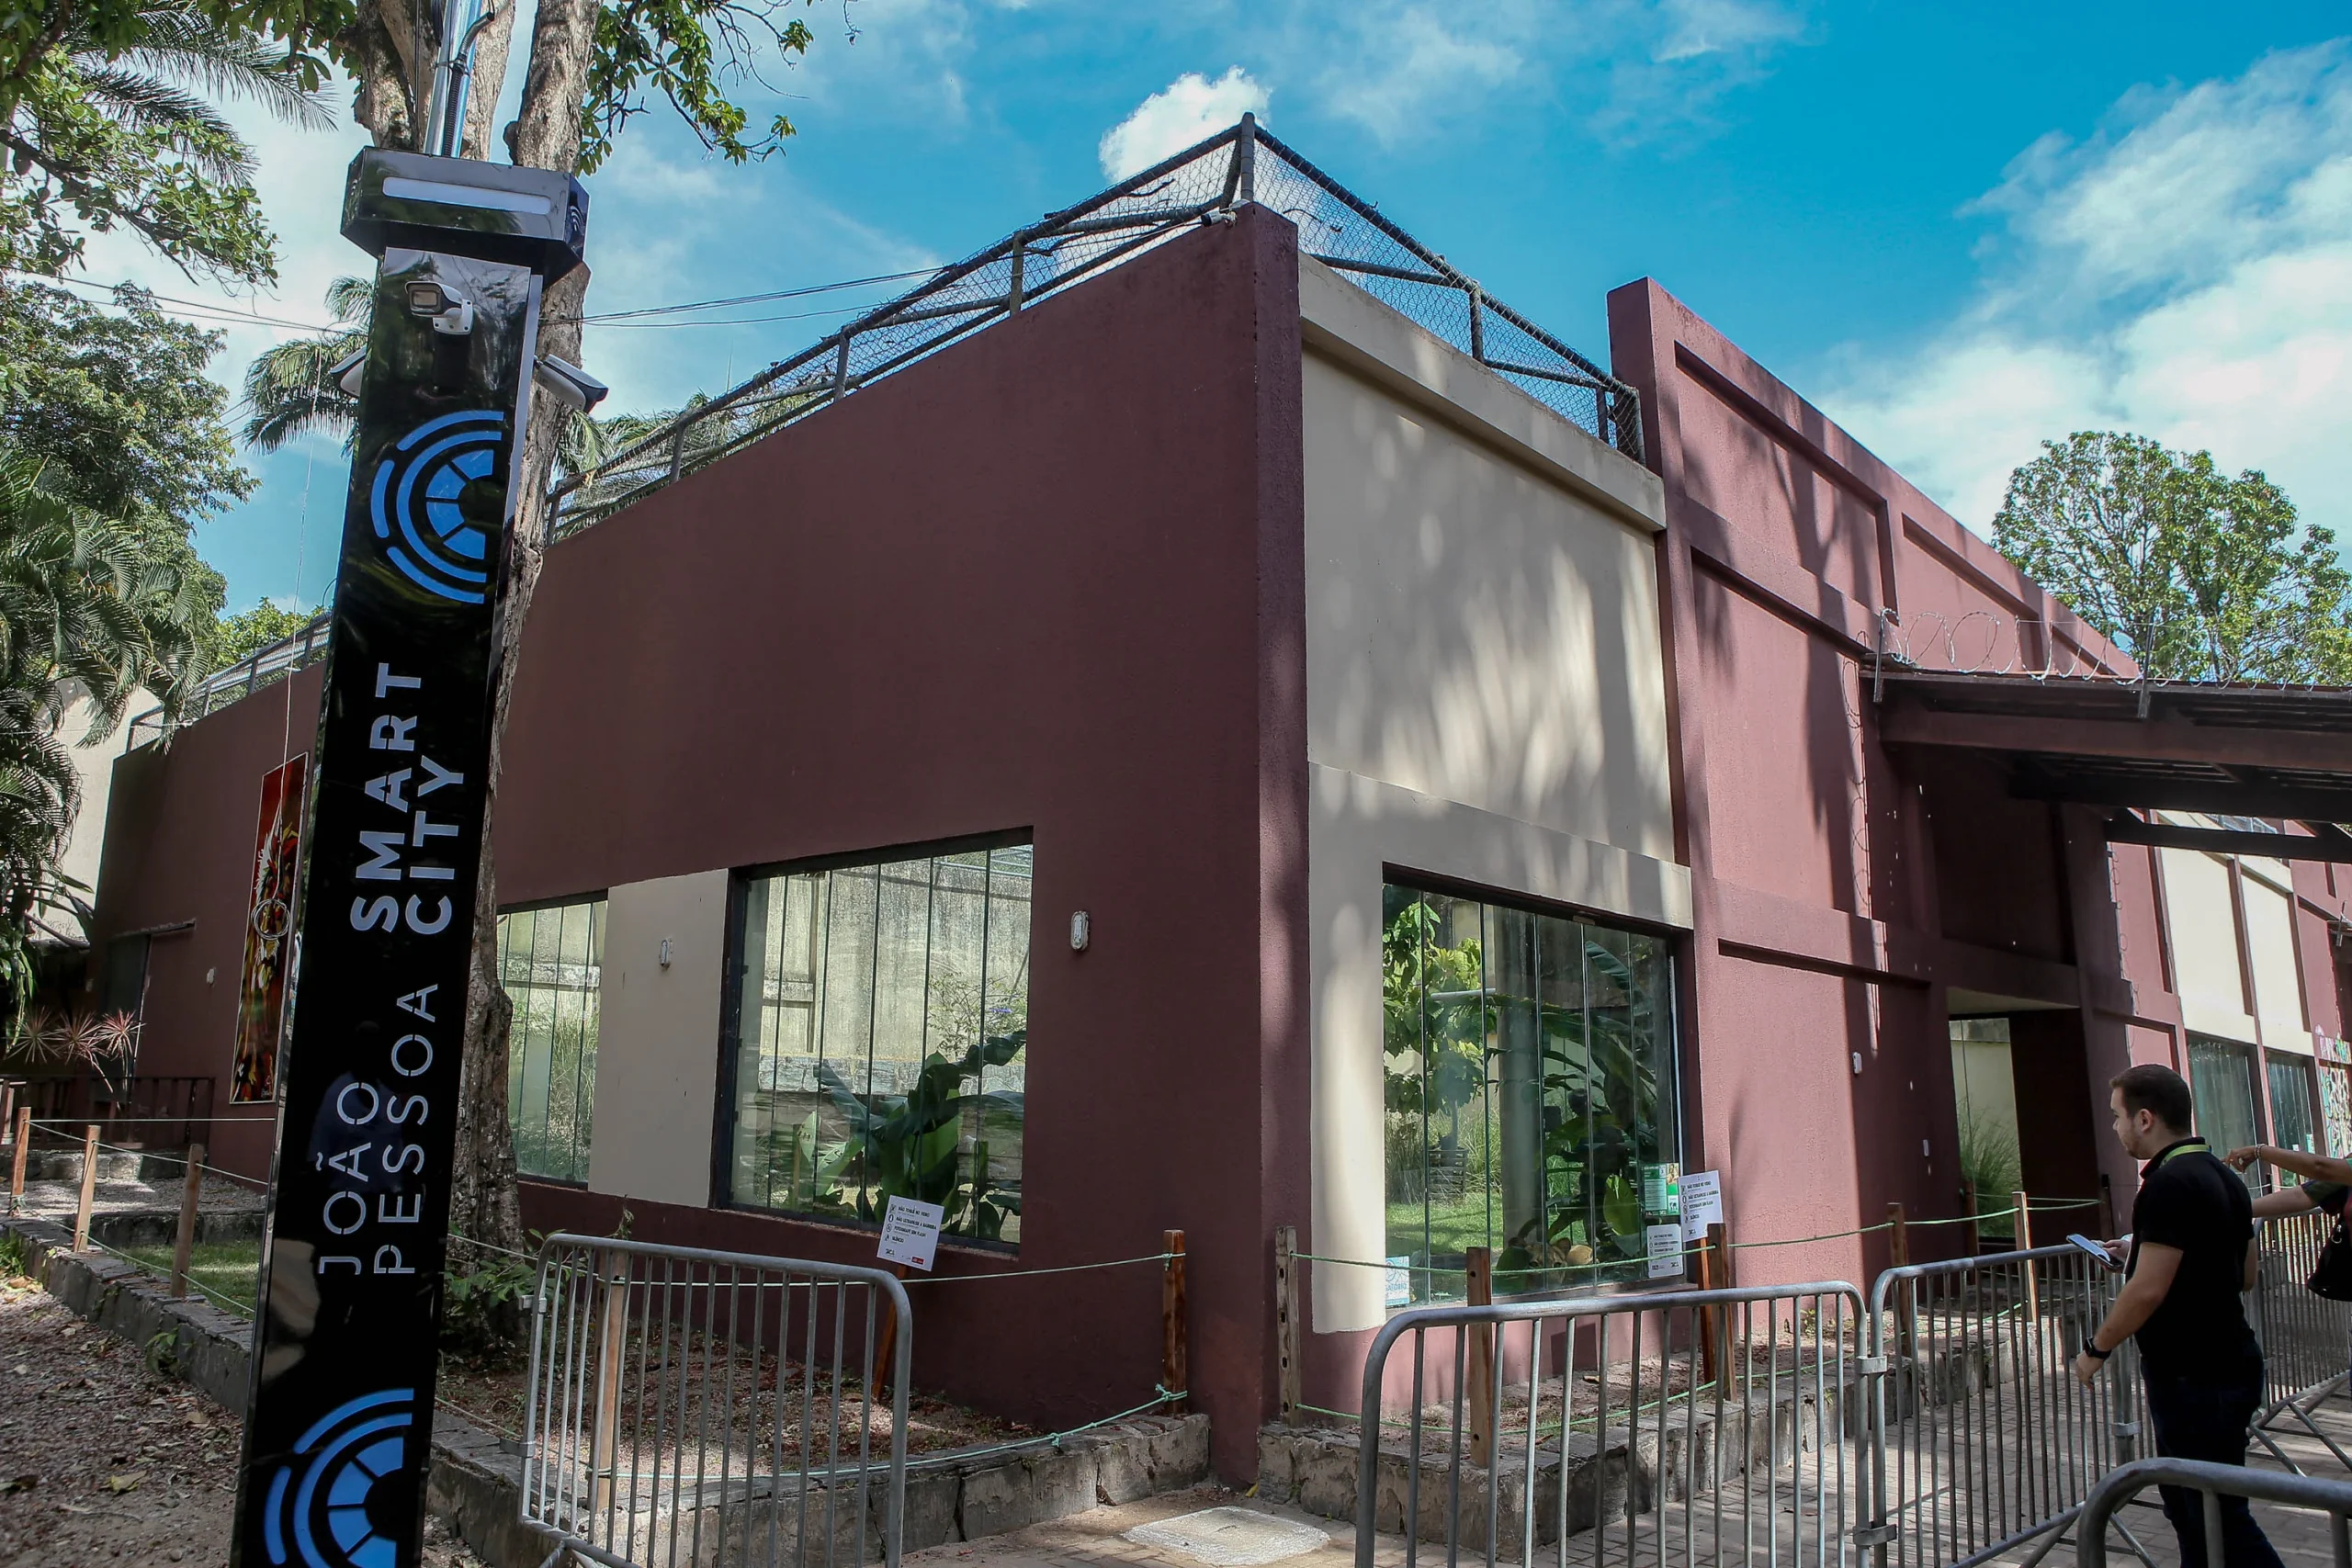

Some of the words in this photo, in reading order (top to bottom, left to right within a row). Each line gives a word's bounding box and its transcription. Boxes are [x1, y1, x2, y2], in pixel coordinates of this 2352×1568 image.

[350, 662, 422, 932] SMART
[405, 755, 464, 934] CITY
[316, 1082, 379, 1274] JOÃO
[374, 984, 439, 1274] PESSOA
